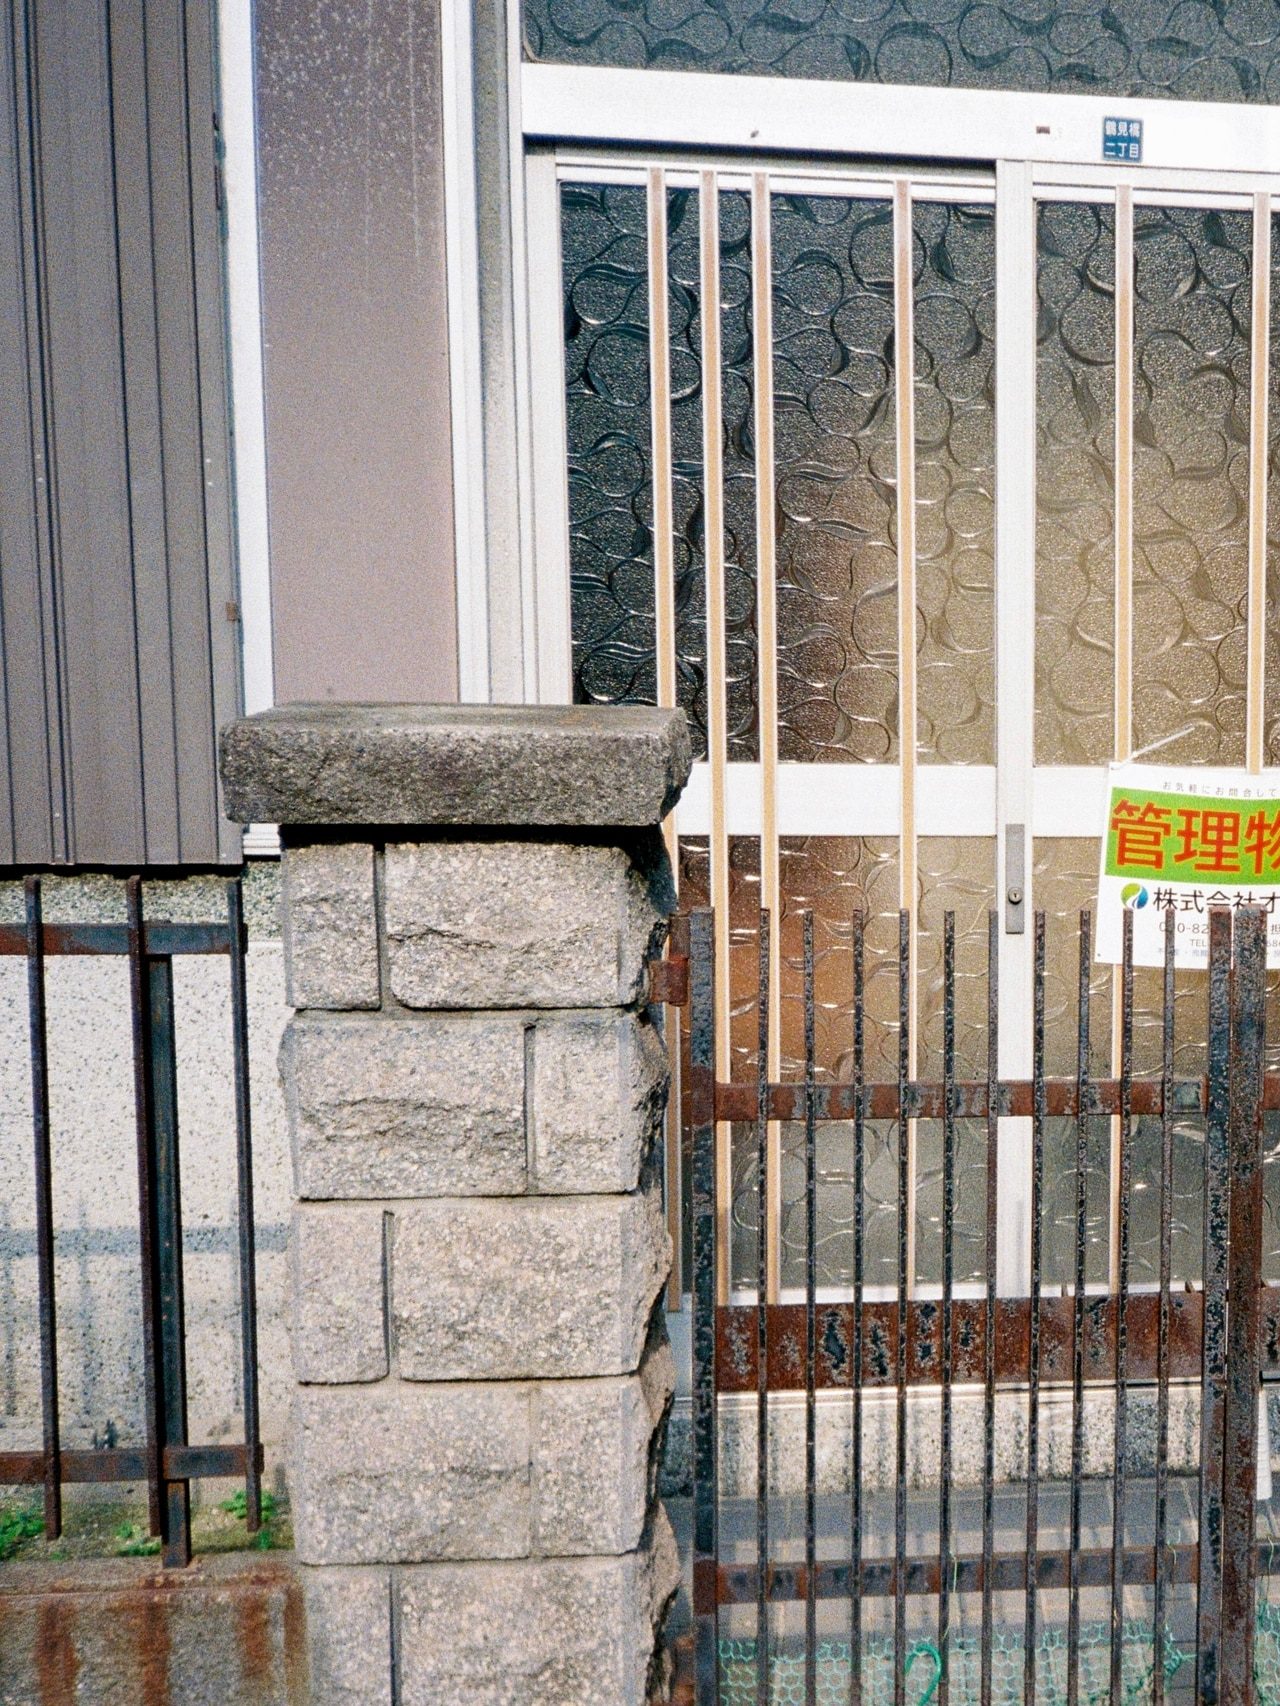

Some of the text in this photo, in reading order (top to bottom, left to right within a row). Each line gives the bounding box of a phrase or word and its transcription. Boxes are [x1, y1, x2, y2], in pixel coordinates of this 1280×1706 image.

[1104, 142, 1139, 158] 二丁目
[1189, 938, 1208, 948] TEL
